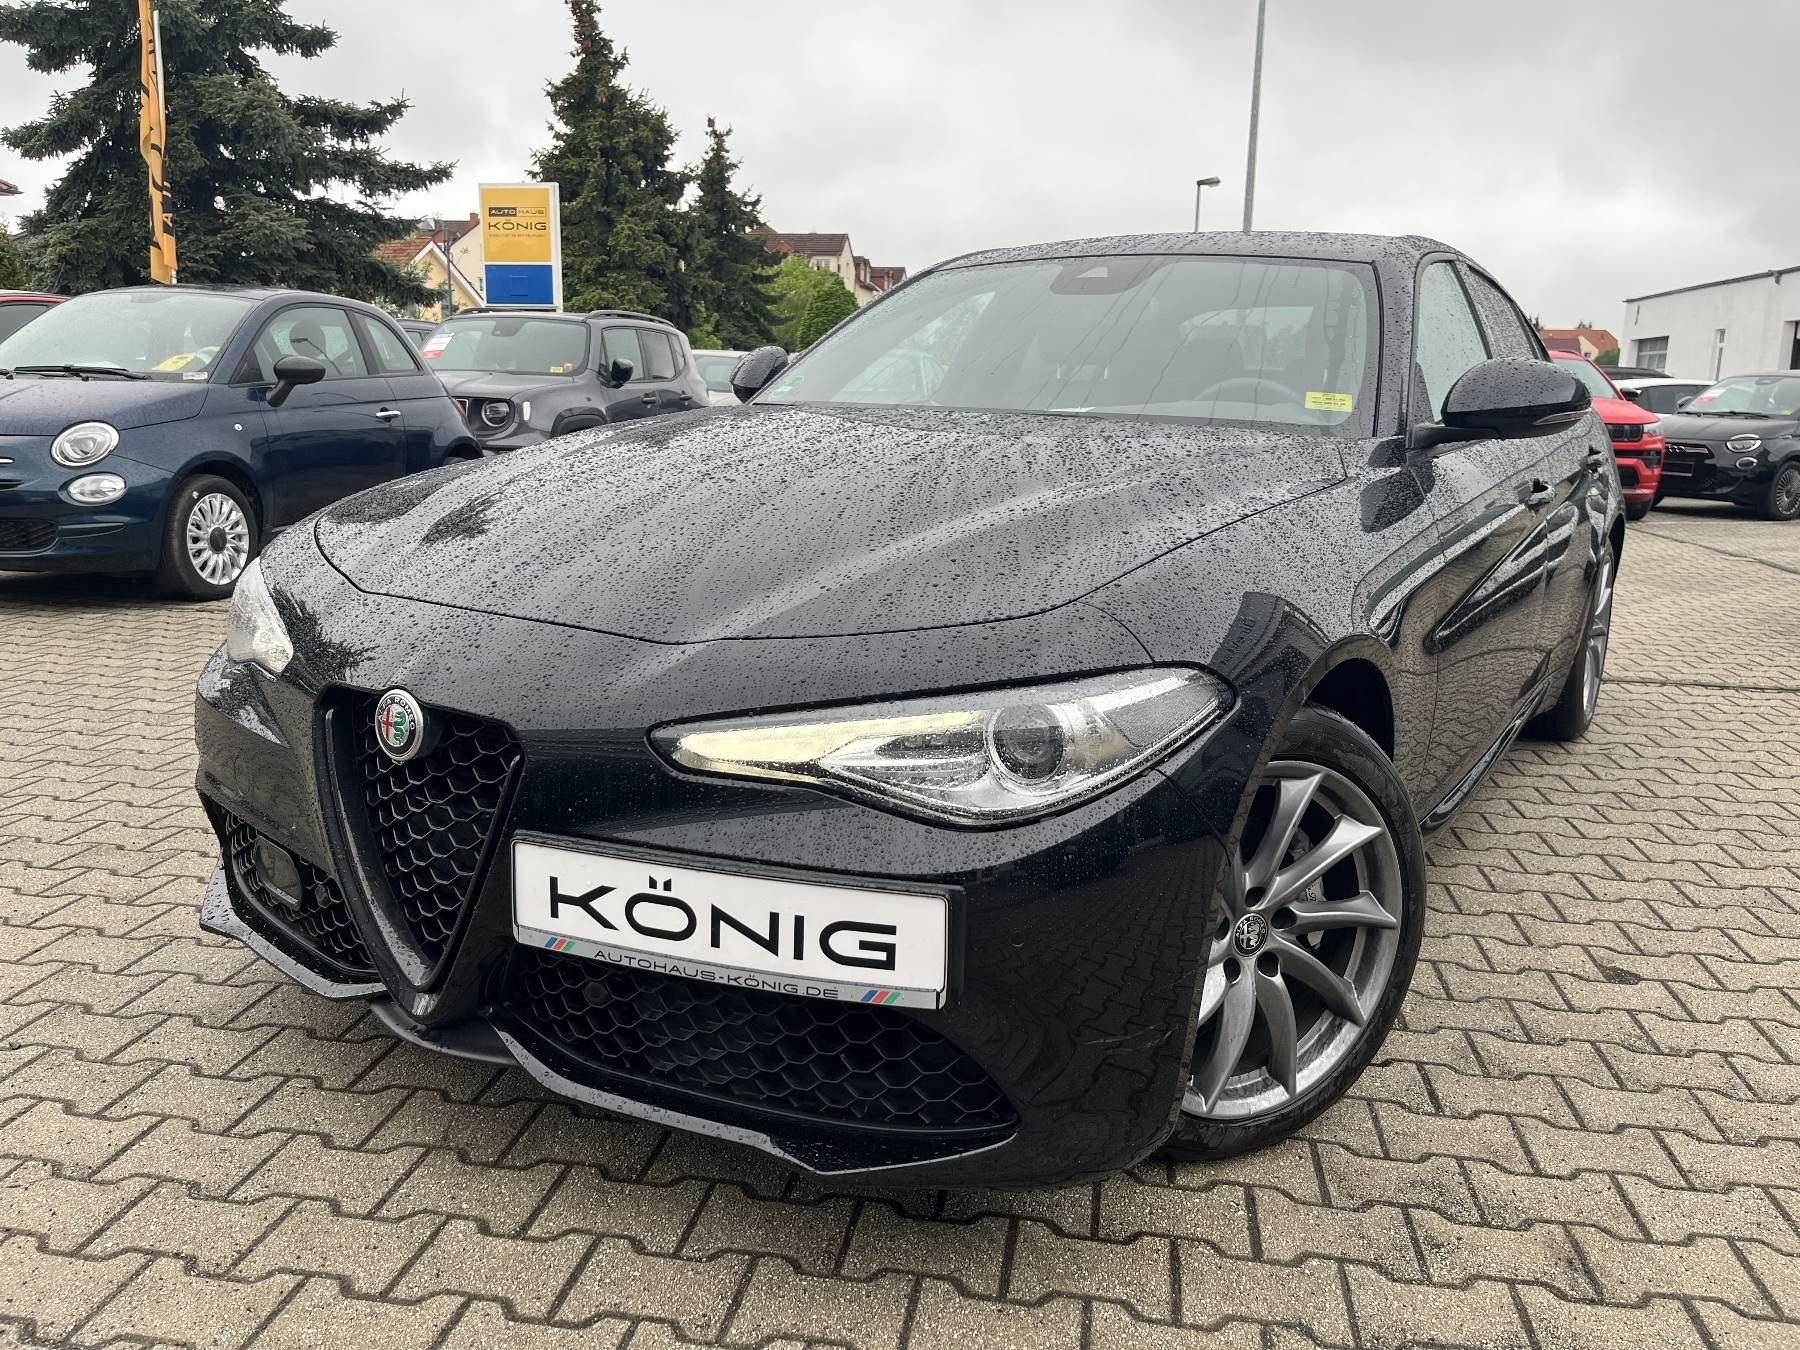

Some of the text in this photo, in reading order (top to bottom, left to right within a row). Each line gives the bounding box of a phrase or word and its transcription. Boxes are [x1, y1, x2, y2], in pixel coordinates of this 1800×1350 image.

[488, 219, 547, 231] KÖNIG
[378, 696, 416, 730] ALFA ROMEO
[549, 874, 897, 971] KÖNIG
[1249, 916, 1266, 934] ROMEO
[594, 949, 839, 999] AUTOHAUS-KÖNIG.DE
